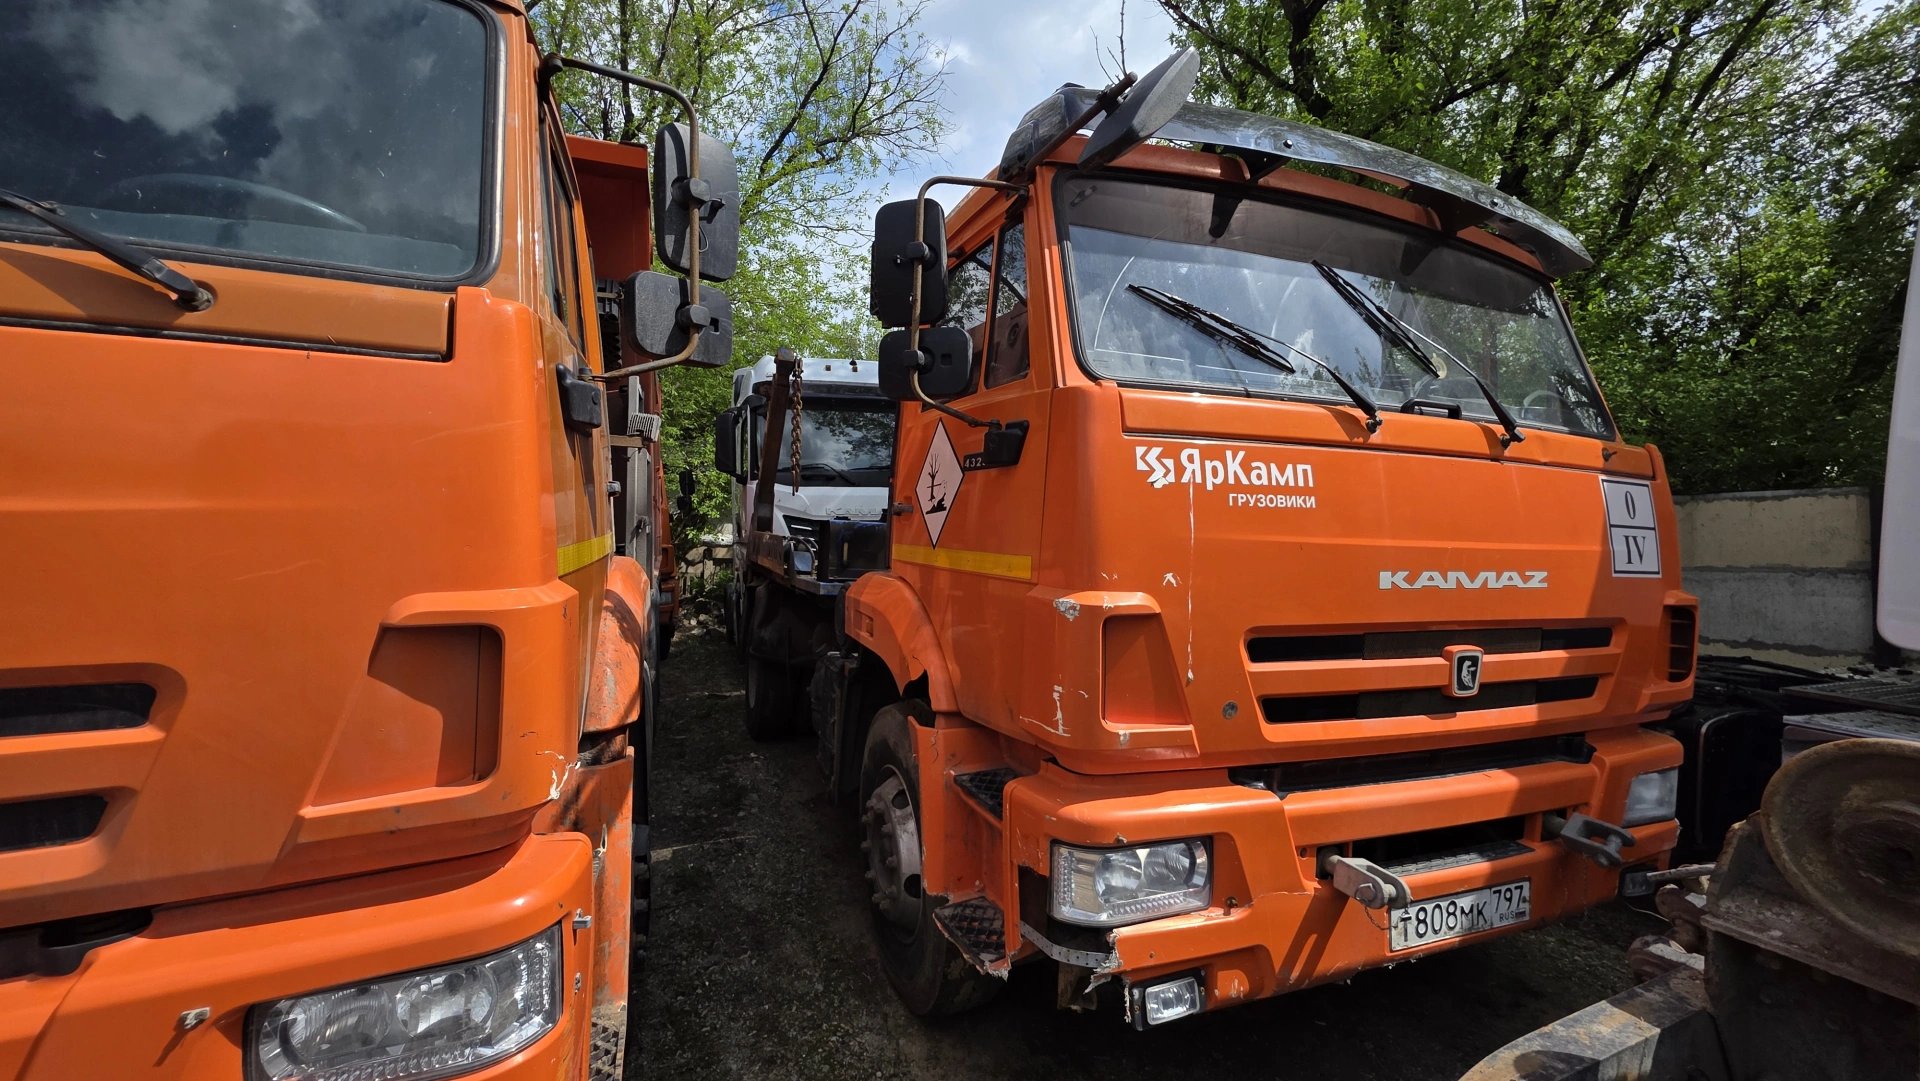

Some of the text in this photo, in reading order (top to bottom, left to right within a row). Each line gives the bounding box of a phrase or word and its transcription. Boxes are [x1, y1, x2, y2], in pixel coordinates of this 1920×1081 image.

[1180, 447, 1314, 490] ЯрКамп
[1228, 493, 1316, 508] ГРУЗОВИКИ
[1622, 534, 1646, 565] IV
[1379, 571, 1548, 589] KAMAZ
[1492, 885, 1524, 915] 797
[1499, 910, 1515, 922] RUS
